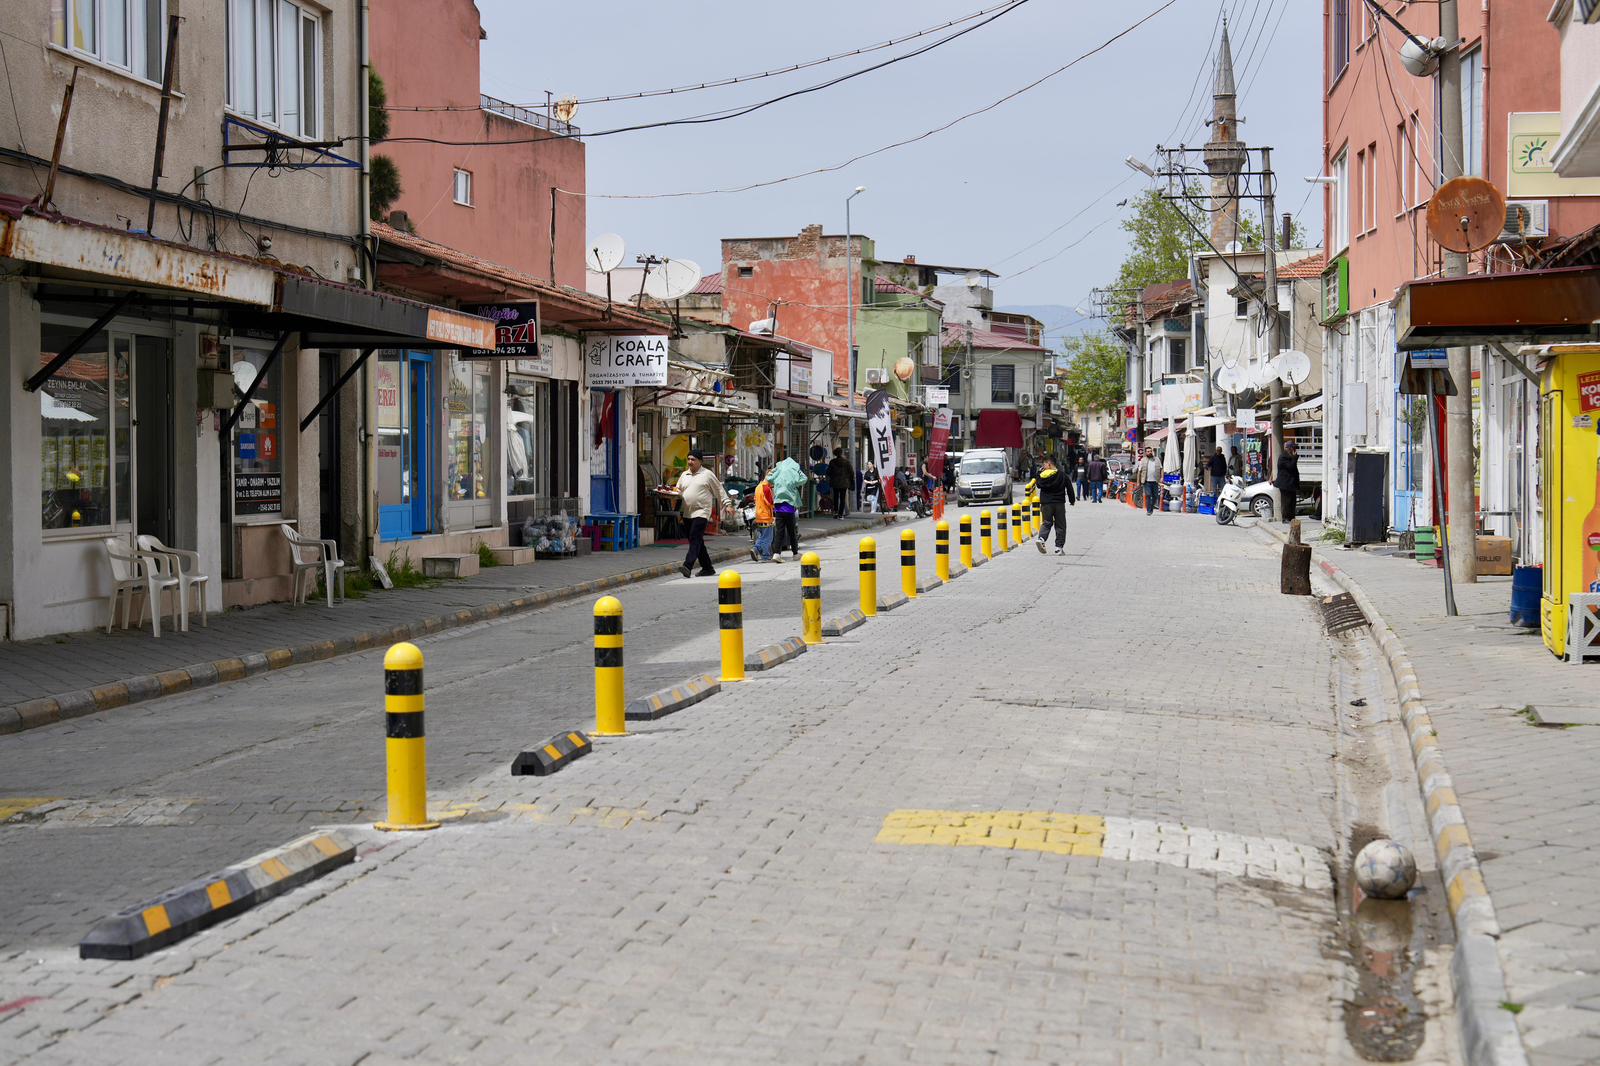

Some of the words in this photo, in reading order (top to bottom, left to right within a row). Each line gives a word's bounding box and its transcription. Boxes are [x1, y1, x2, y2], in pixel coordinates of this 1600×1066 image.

[496, 319, 536, 343] RZİ
[506, 346, 516, 354] 25
[516, 346, 527, 354] 74
[615, 340, 665, 353] KOALA
[614, 354, 665, 367] CRAFT
[876, 426, 889, 469] TEK
